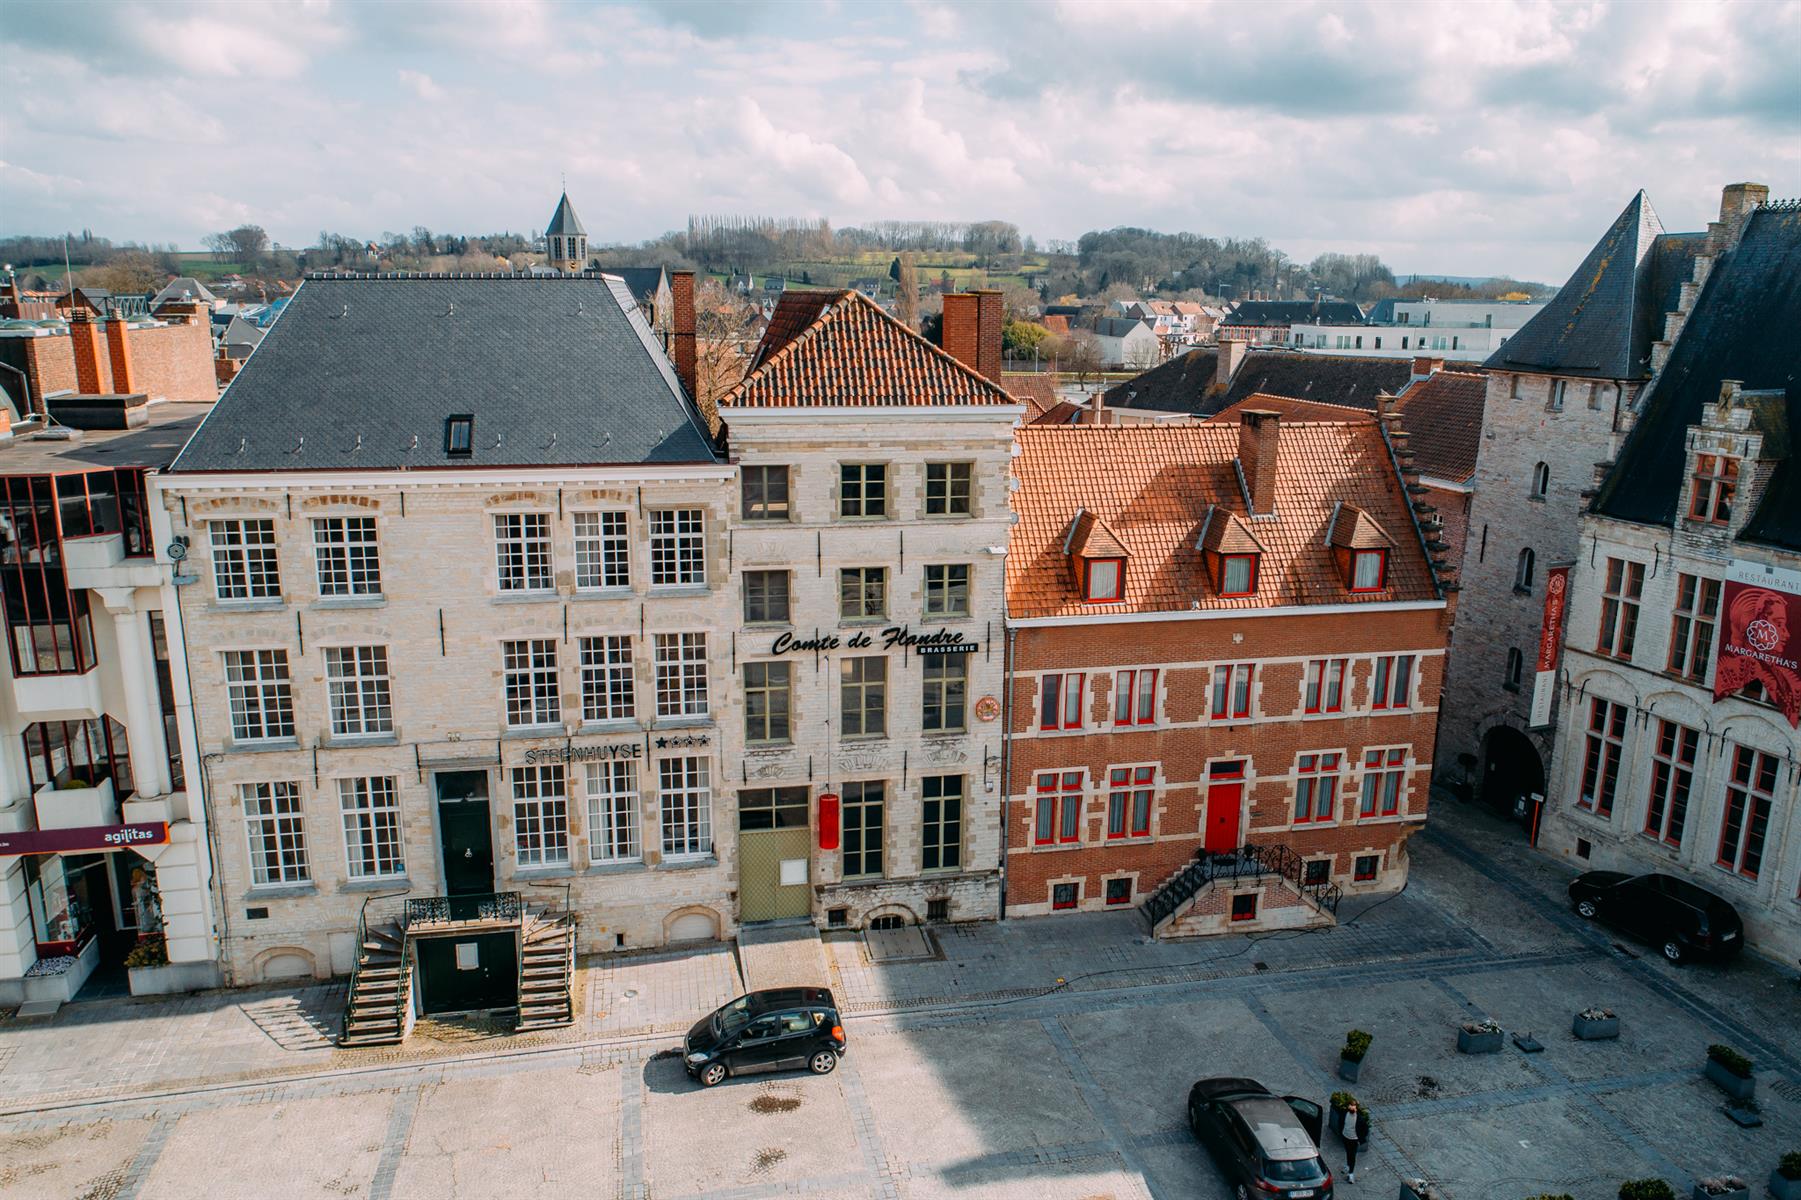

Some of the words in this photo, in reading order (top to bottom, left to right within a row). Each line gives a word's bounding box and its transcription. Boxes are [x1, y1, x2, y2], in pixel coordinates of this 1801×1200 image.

[1738, 571, 1800, 590] RESTAURANT
[771, 631, 840, 655] Comte
[848, 631, 872, 648] de
[881, 627, 965, 650] Flandre
[1756, 630, 1768, 641] M
[920, 644, 975, 654] BRASSERIE
[1725, 643, 1798, 669] MARGARETHA'S
[525, 743, 642, 765] STEENHUYSE
[104, 829, 153, 844] agilitas
